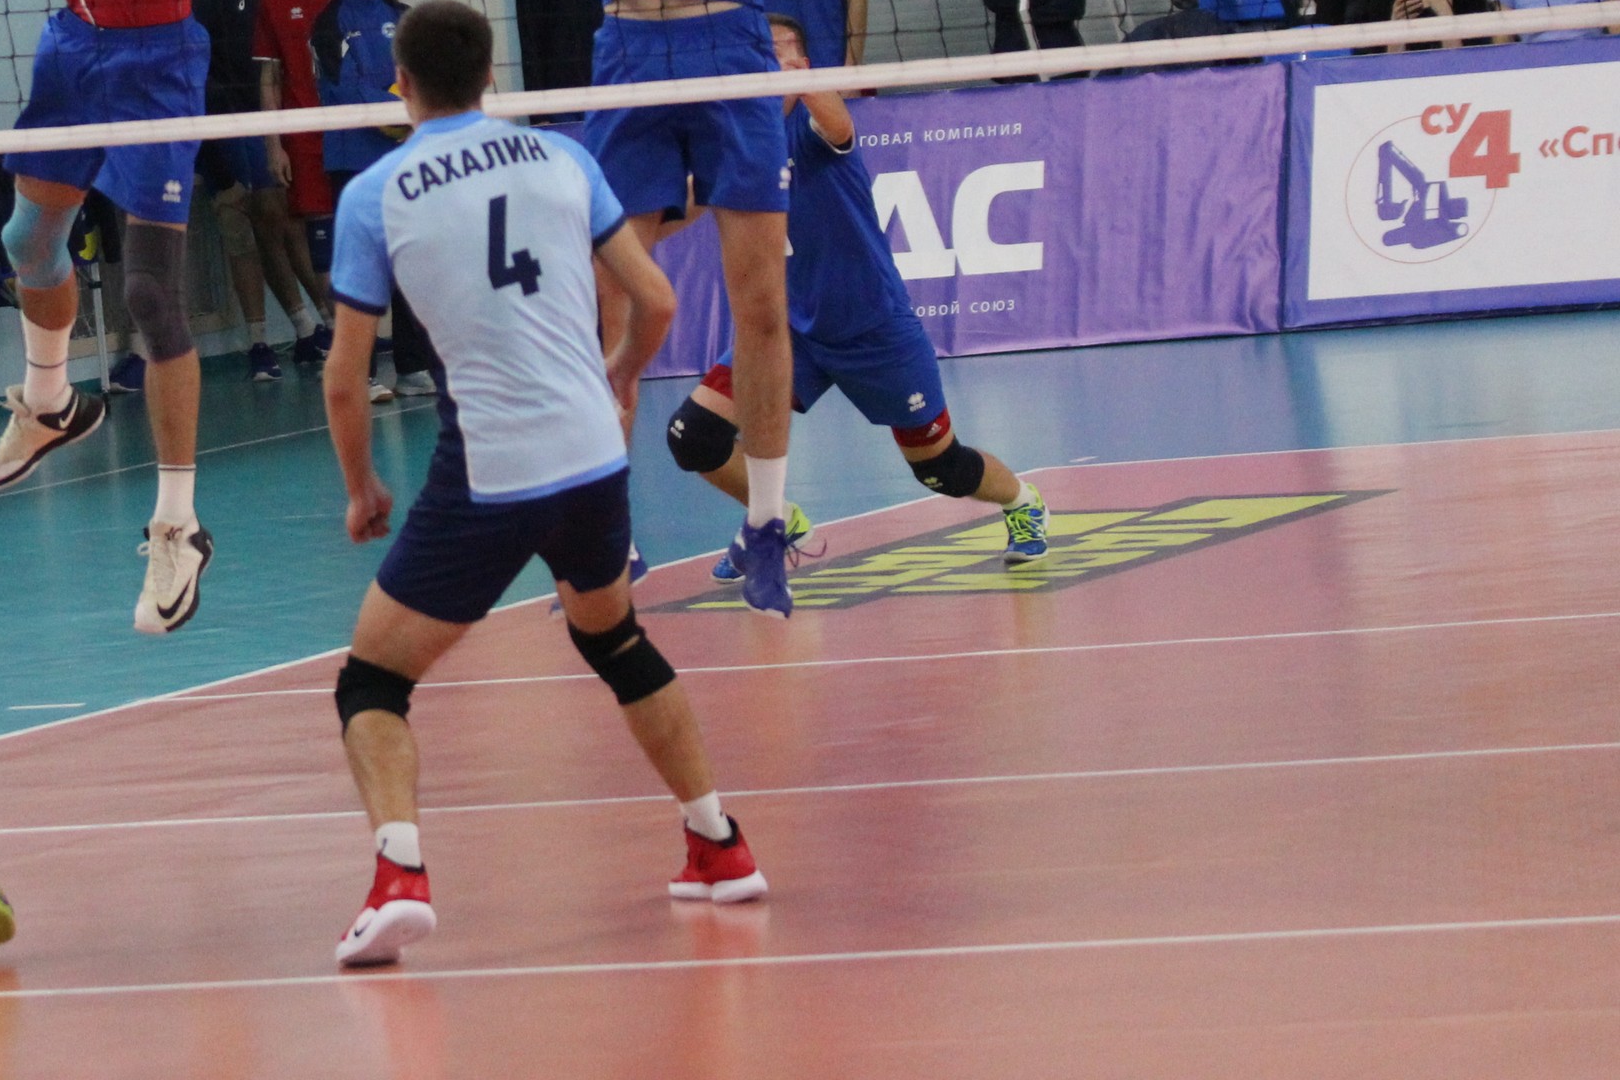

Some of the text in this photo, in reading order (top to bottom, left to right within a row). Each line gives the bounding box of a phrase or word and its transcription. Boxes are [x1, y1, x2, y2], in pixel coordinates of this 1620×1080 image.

[923, 122, 1023, 143] КОМПАНИЯ
[1421, 102, 1521, 189] СУ 4
[1538, 125, 1620, 158] «Сп
[397, 133, 549, 201] САХАЛИН
[487, 194, 542, 297] 4
[911, 299, 1016, 318] ОВОЙ СОЮЗ
